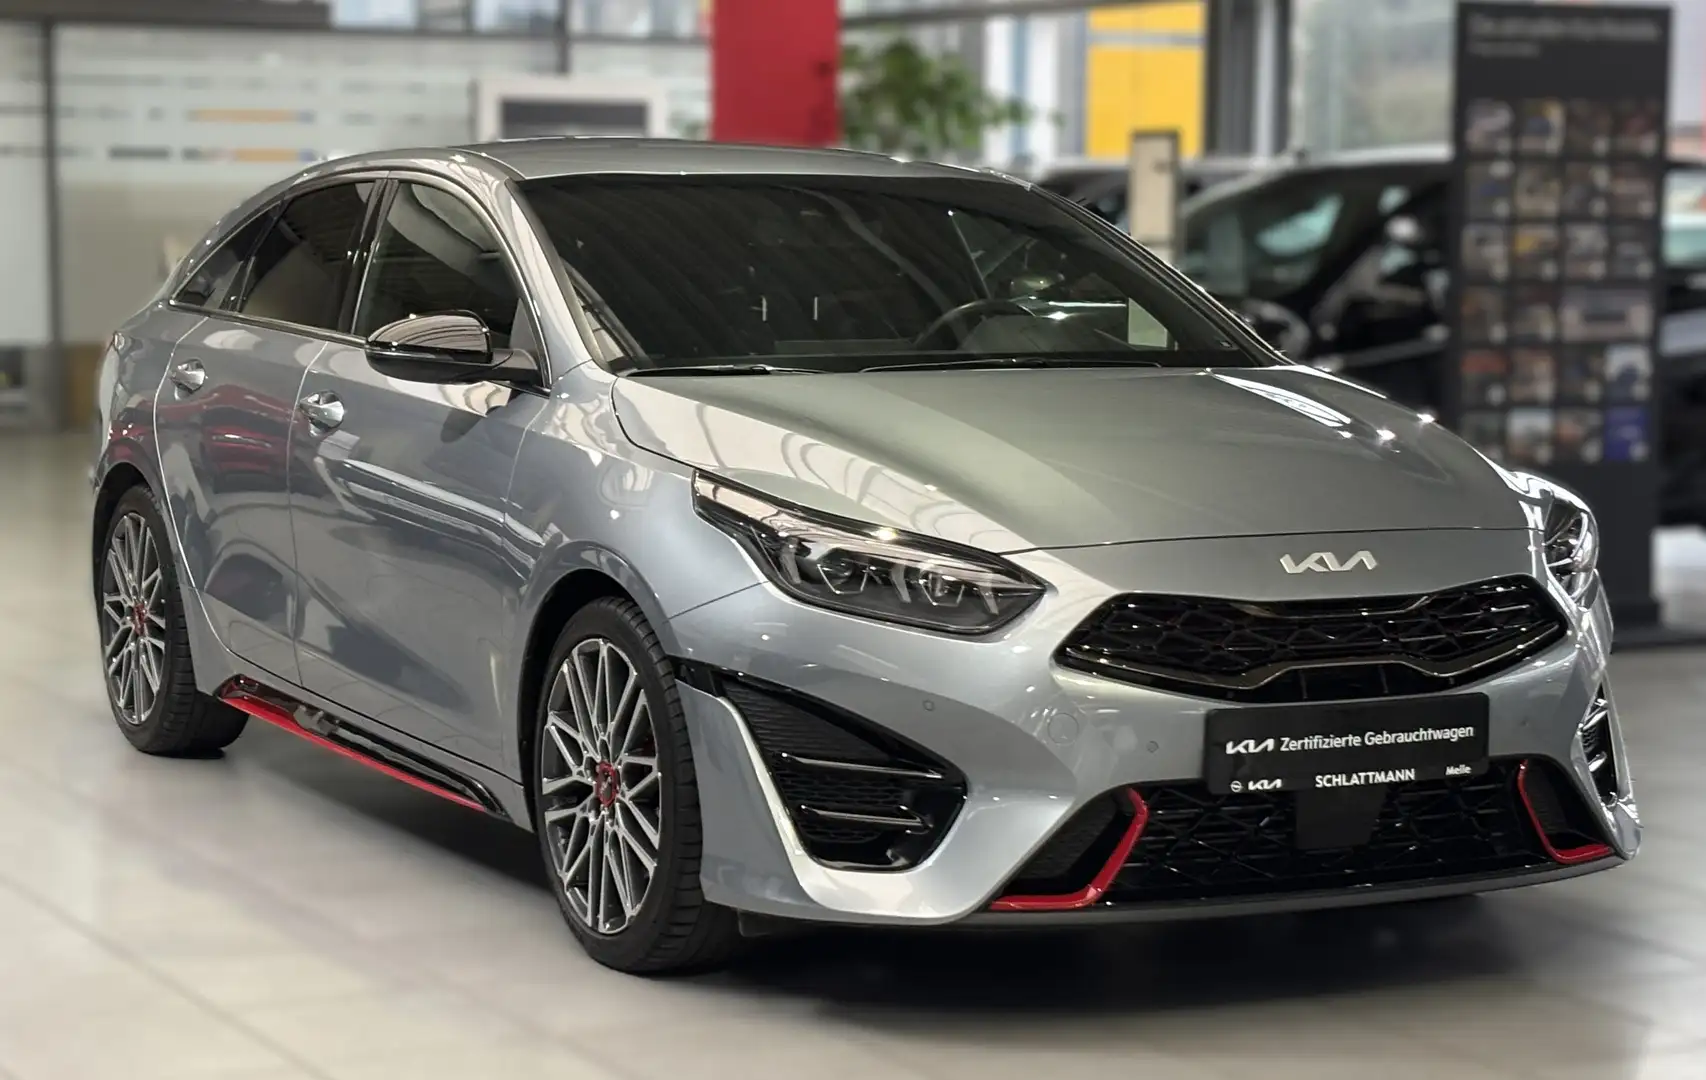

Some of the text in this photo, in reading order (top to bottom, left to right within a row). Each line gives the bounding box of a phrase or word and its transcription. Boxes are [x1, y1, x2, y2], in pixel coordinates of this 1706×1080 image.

[1280, 550, 1378, 574] KIA
[1225, 726, 1474, 755] KIA Zertifizierte Gebrauchtwagen
[1248, 779, 1282, 791] KIA
[1315, 768, 1416, 788] SCHLATTMANN
